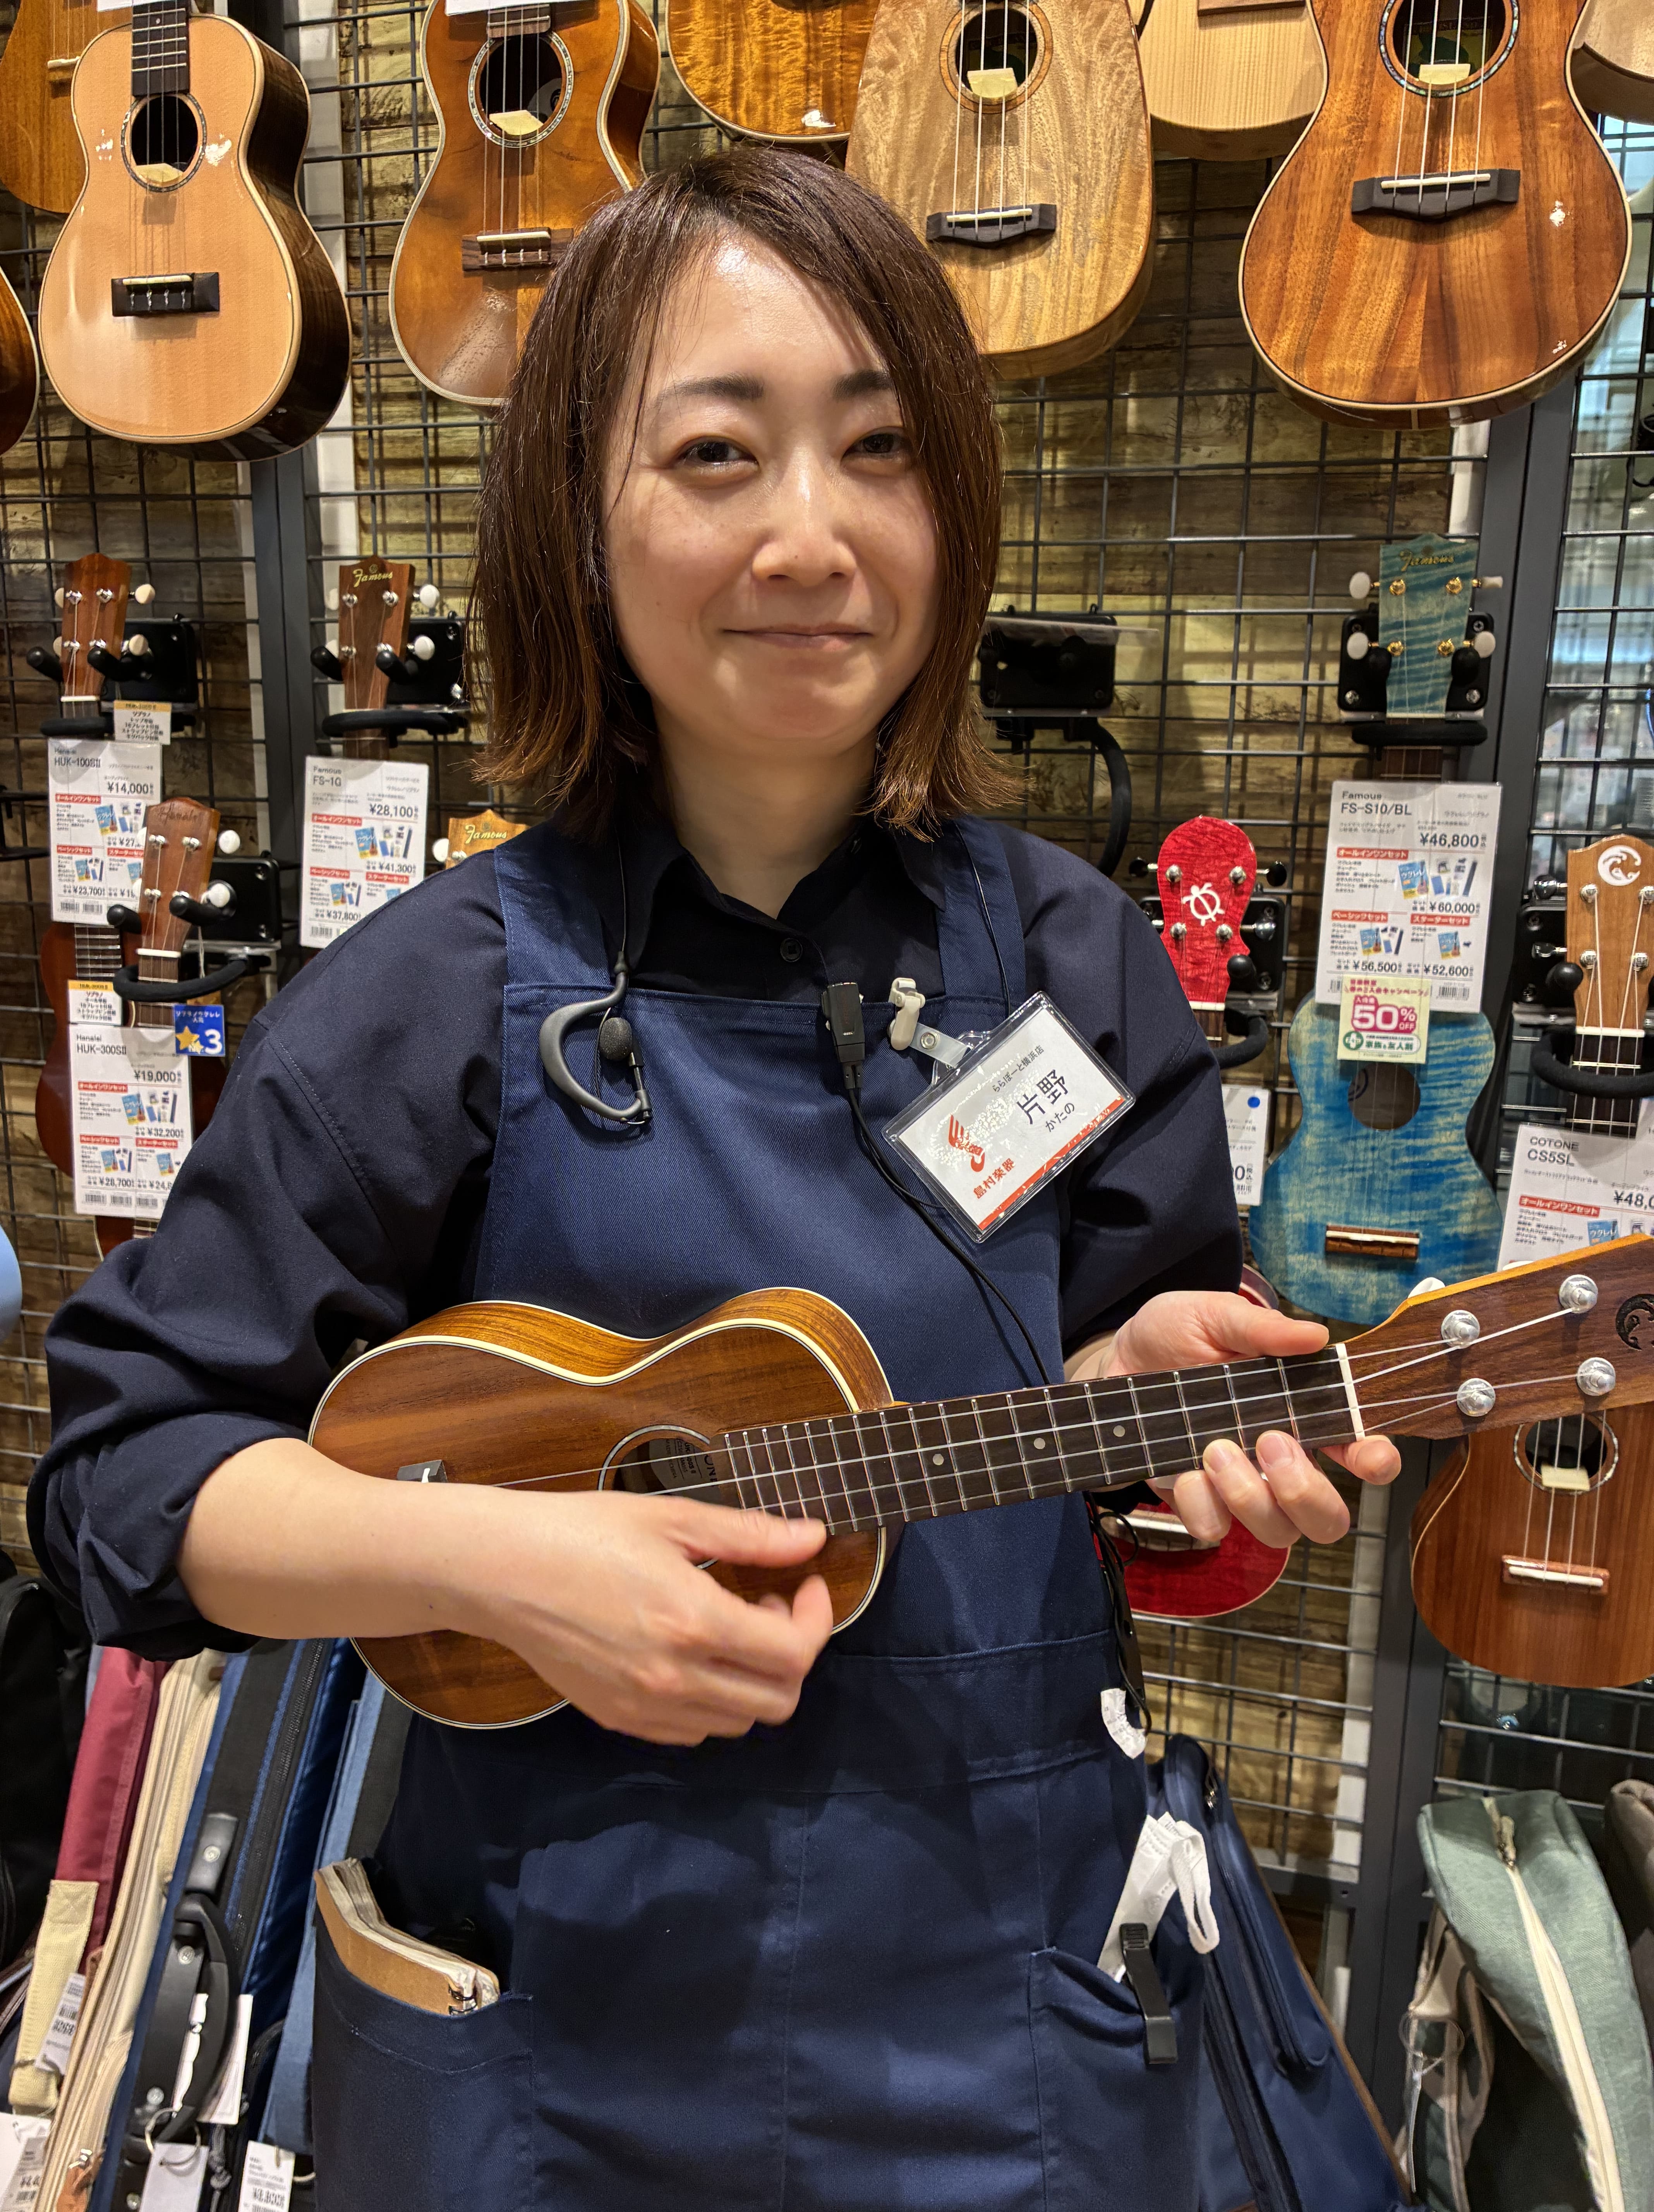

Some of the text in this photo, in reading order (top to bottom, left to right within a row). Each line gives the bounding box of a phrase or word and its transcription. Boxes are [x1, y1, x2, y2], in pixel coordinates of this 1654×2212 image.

[1400, 549, 1455, 572] Famous
[353, 568, 393, 587] Famous
[108, 781, 149, 794] ¥14,000
[1342, 790, 1382, 800] Famous
[369, 804, 413, 818] ¥28,100
[1341, 802, 1412, 816] FS-S10/BL
[465, 824, 507, 844] Famous
[1420, 833, 1479, 848] ¥46,800
[1339, 849, 1408, 859] オールインワンセット
[379, 862, 412, 874] ¥41,300
[1429, 902, 1475, 914] ¥60,000
[1332, 912, 1387, 921] ベーシックセット
[1412, 916, 1469, 926] スターターセット
[1353, 960, 1397, 973] ¥56,500
[1424, 964, 1469, 977] ¥52,600
[1399, 1022, 1415, 1030] OFF
[992, 1045, 1045, 1093] ららぽーと横浜店
[134, 1070, 177, 1083] ¥19,000
[1016, 1069, 1069, 1125] 片野
[1045, 1101, 1076, 1132] かたの
[1530, 1136, 1580, 1152] COTONE
[1527, 1148, 1575, 1167] CS5SL
[973, 1158, 1016, 1199] 島村楽器
[1521, 1197, 1599, 1216] オールインワンセット
